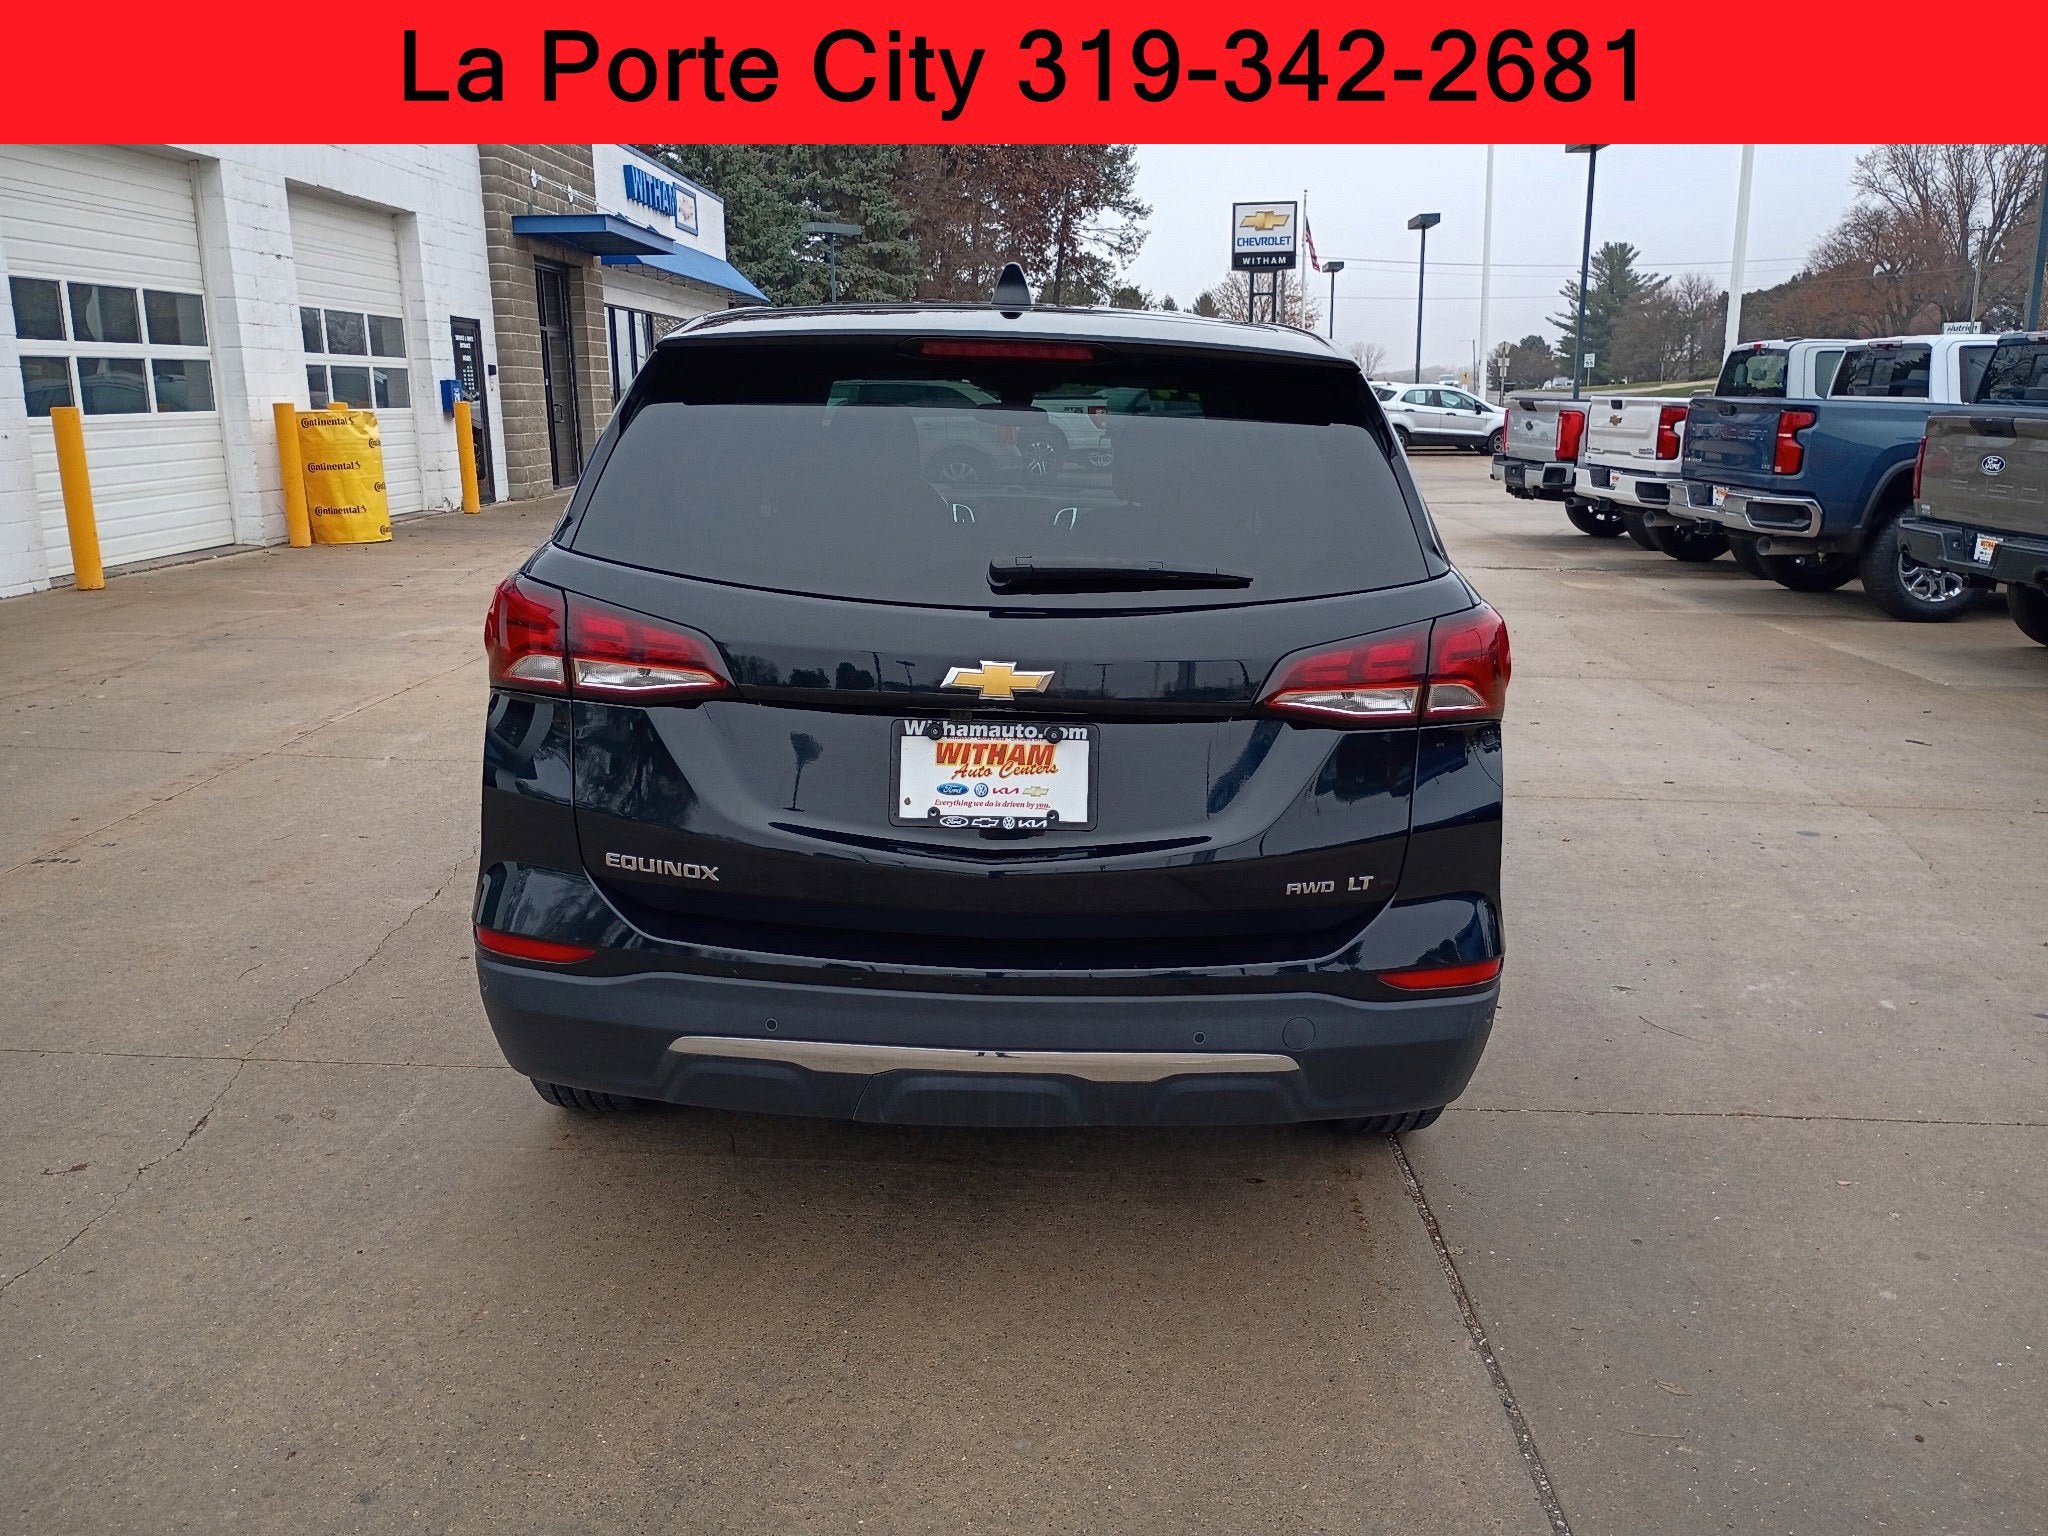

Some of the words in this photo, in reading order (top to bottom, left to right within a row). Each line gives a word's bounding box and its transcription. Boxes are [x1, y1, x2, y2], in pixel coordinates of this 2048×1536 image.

[1237, 236, 1291, 246] CHEVROLET
[1242, 256, 1287, 265] WITHAM
[301, 417, 347, 428] Continental
[308, 462, 354, 473] Continental
[315, 506, 360, 517] Continental
[936, 742, 1055, 766] WITHAM
[951, 764, 993, 780] Auto
[998, 761, 1059, 779] Centers
[934, 799, 973, 808] Everything
[605, 852, 720, 881] EQUINOX
[1286, 881, 1335, 895] AWD
[1347, 875, 1374, 891] LT
